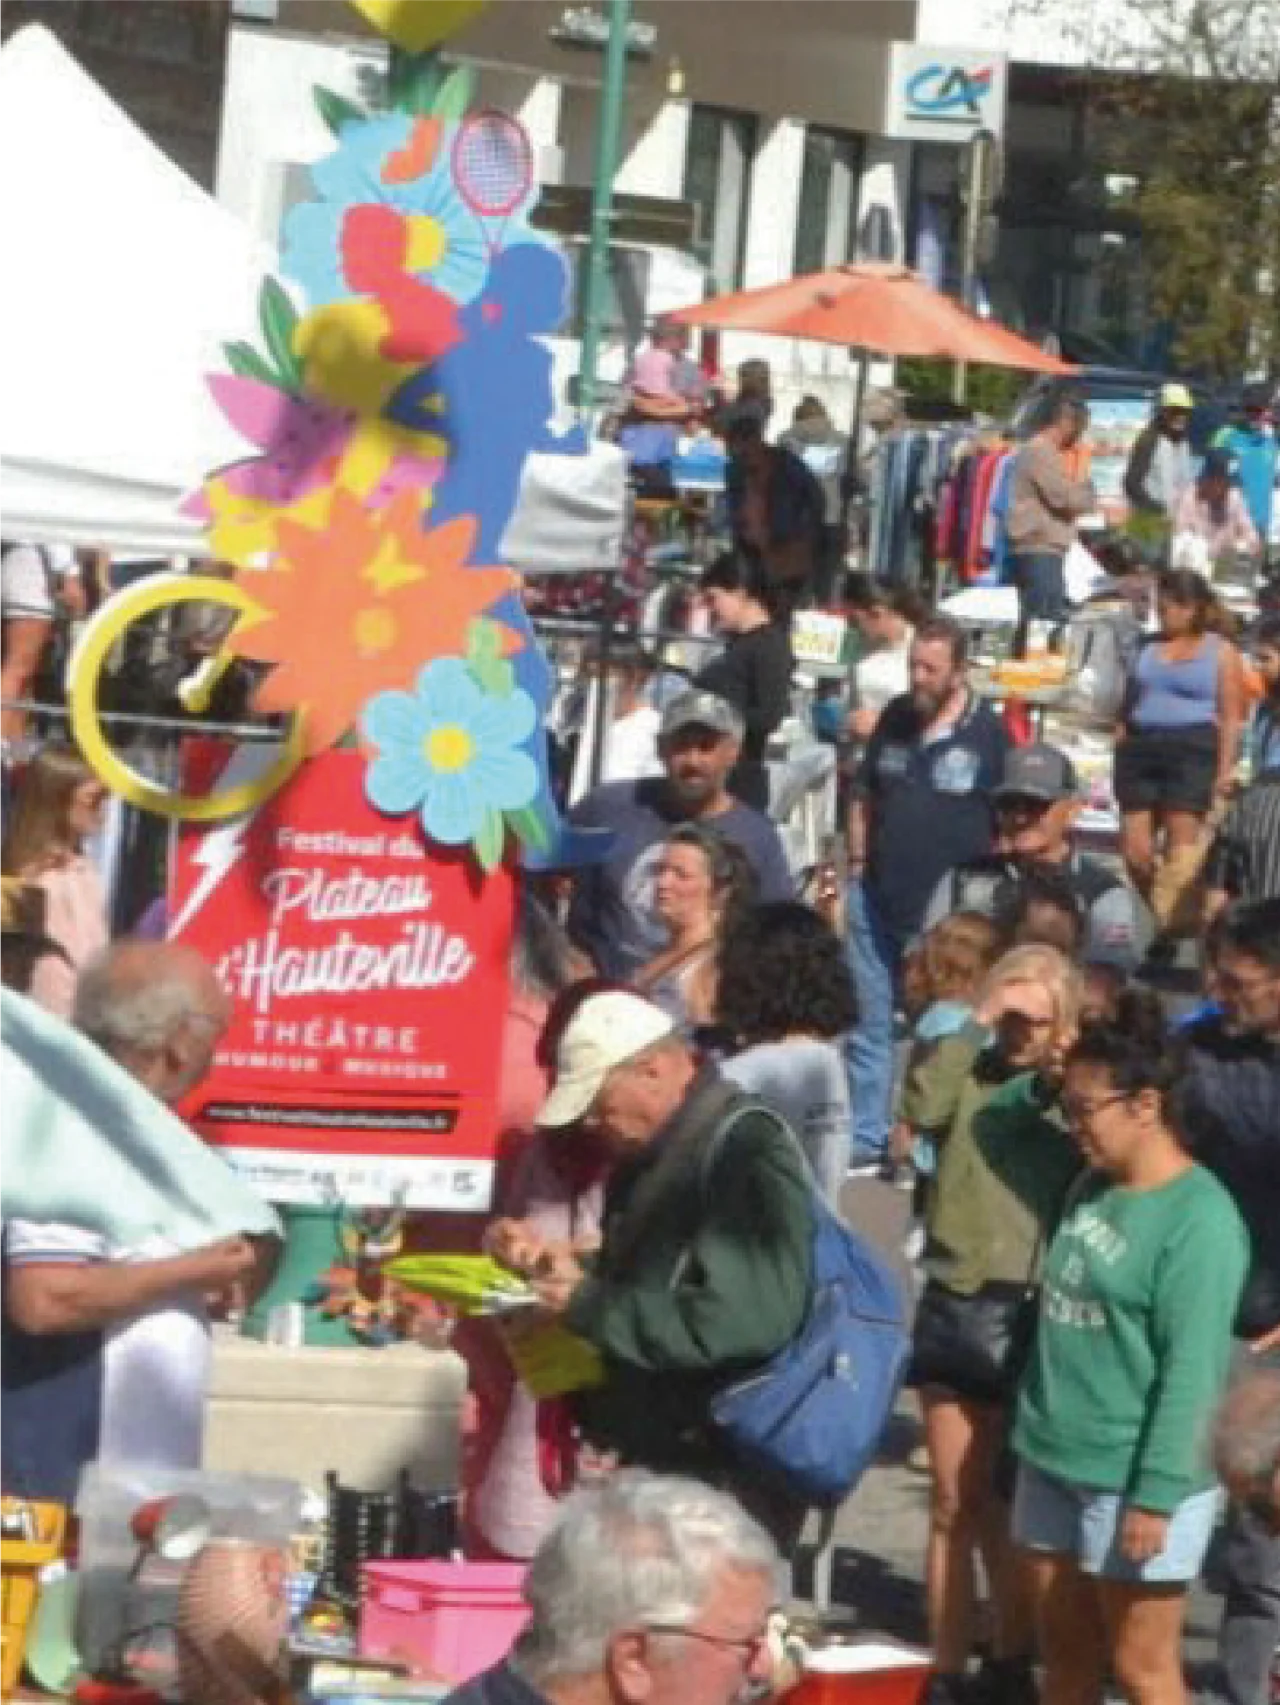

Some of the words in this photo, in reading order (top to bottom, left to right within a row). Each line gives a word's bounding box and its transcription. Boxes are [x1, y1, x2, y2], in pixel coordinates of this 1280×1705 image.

[277, 827, 386, 854] Festival
[261, 866, 433, 928] Plateau
[253, 1015, 420, 1053] THÉÂTRE
[342, 1057, 448, 1079] MUSIQUE
